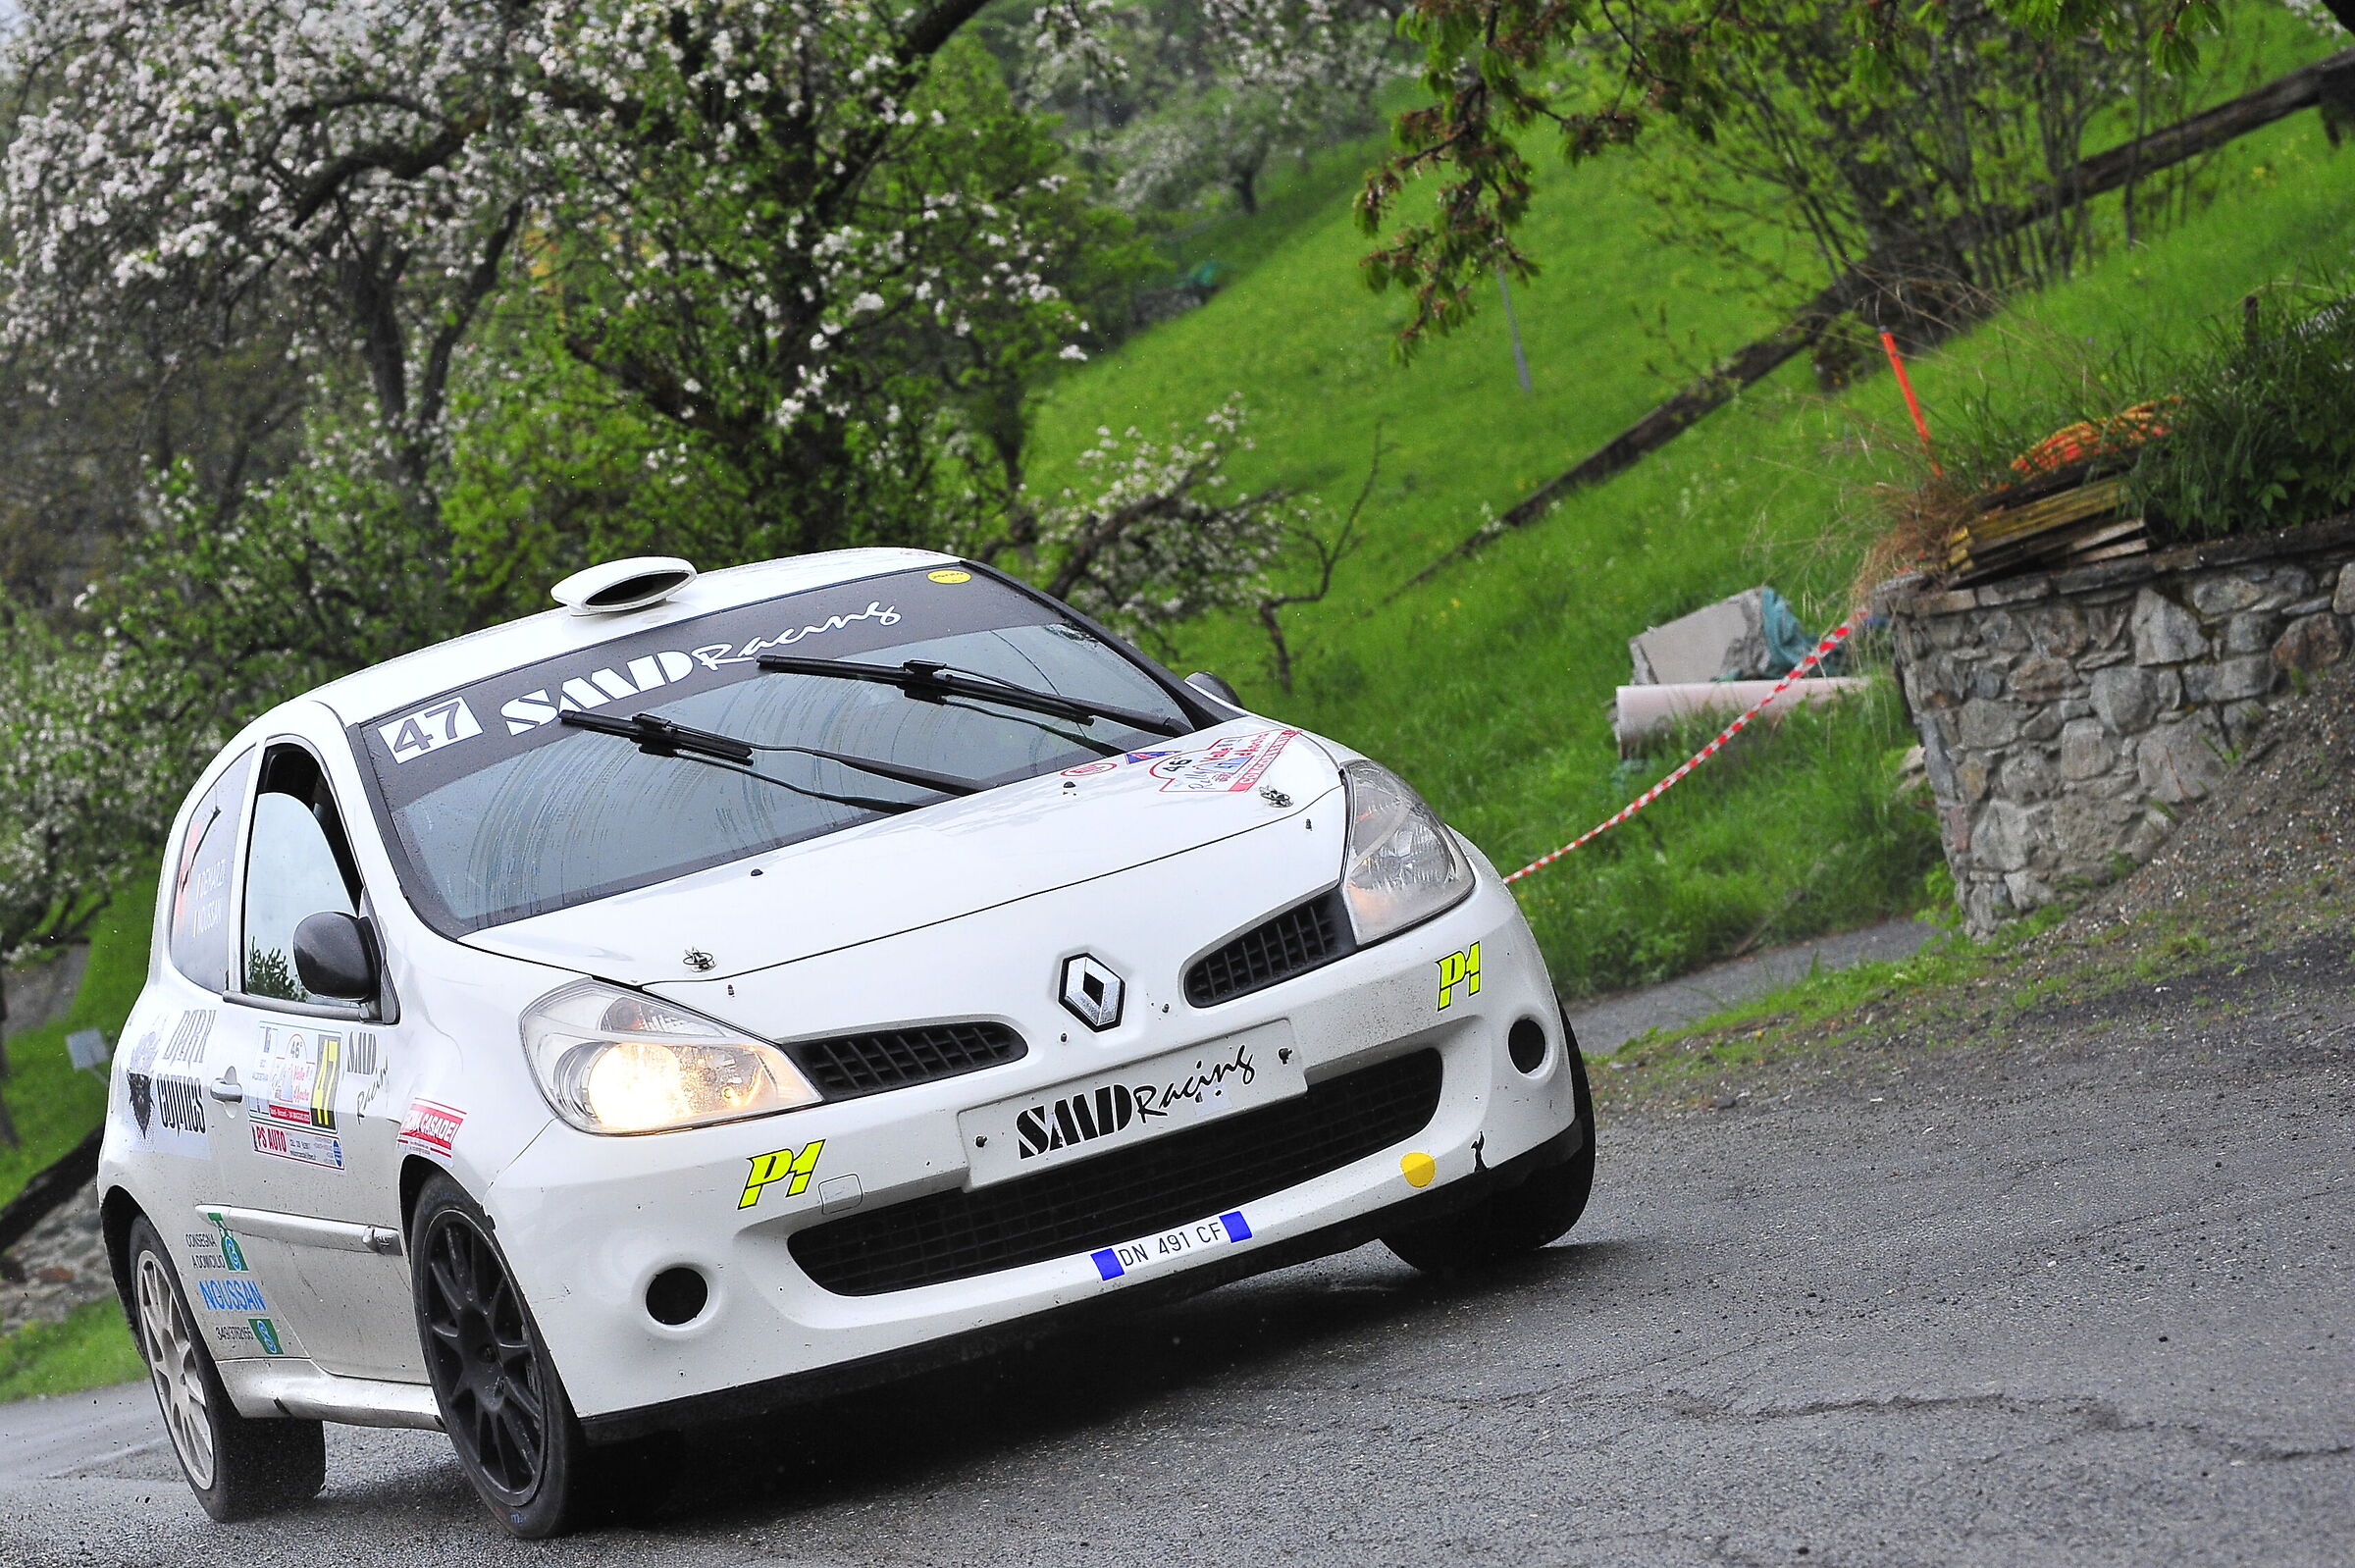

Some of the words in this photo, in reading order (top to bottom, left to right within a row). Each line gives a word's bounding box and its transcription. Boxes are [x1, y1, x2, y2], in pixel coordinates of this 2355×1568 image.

[691, 601, 903, 671] Racing
[393, 701, 460, 754] 47
[1435, 941, 1481, 1012] P1
[420, 1113, 460, 1143] CASADEI
[1016, 1083, 1132, 1160] SMD
[1133, 1044, 1256, 1124] Racing
[256, 1125, 268, 1149] PS
[267, 1127, 288, 1153] AUTO
[737, 1138, 826, 1210] P1
[185, 1233, 217, 1247] CONSEGNA
[1118, 1243, 1149, 1267] DN
[1158, 1231, 1191, 1255] 491
[1196, 1222, 1223, 1243] CF
